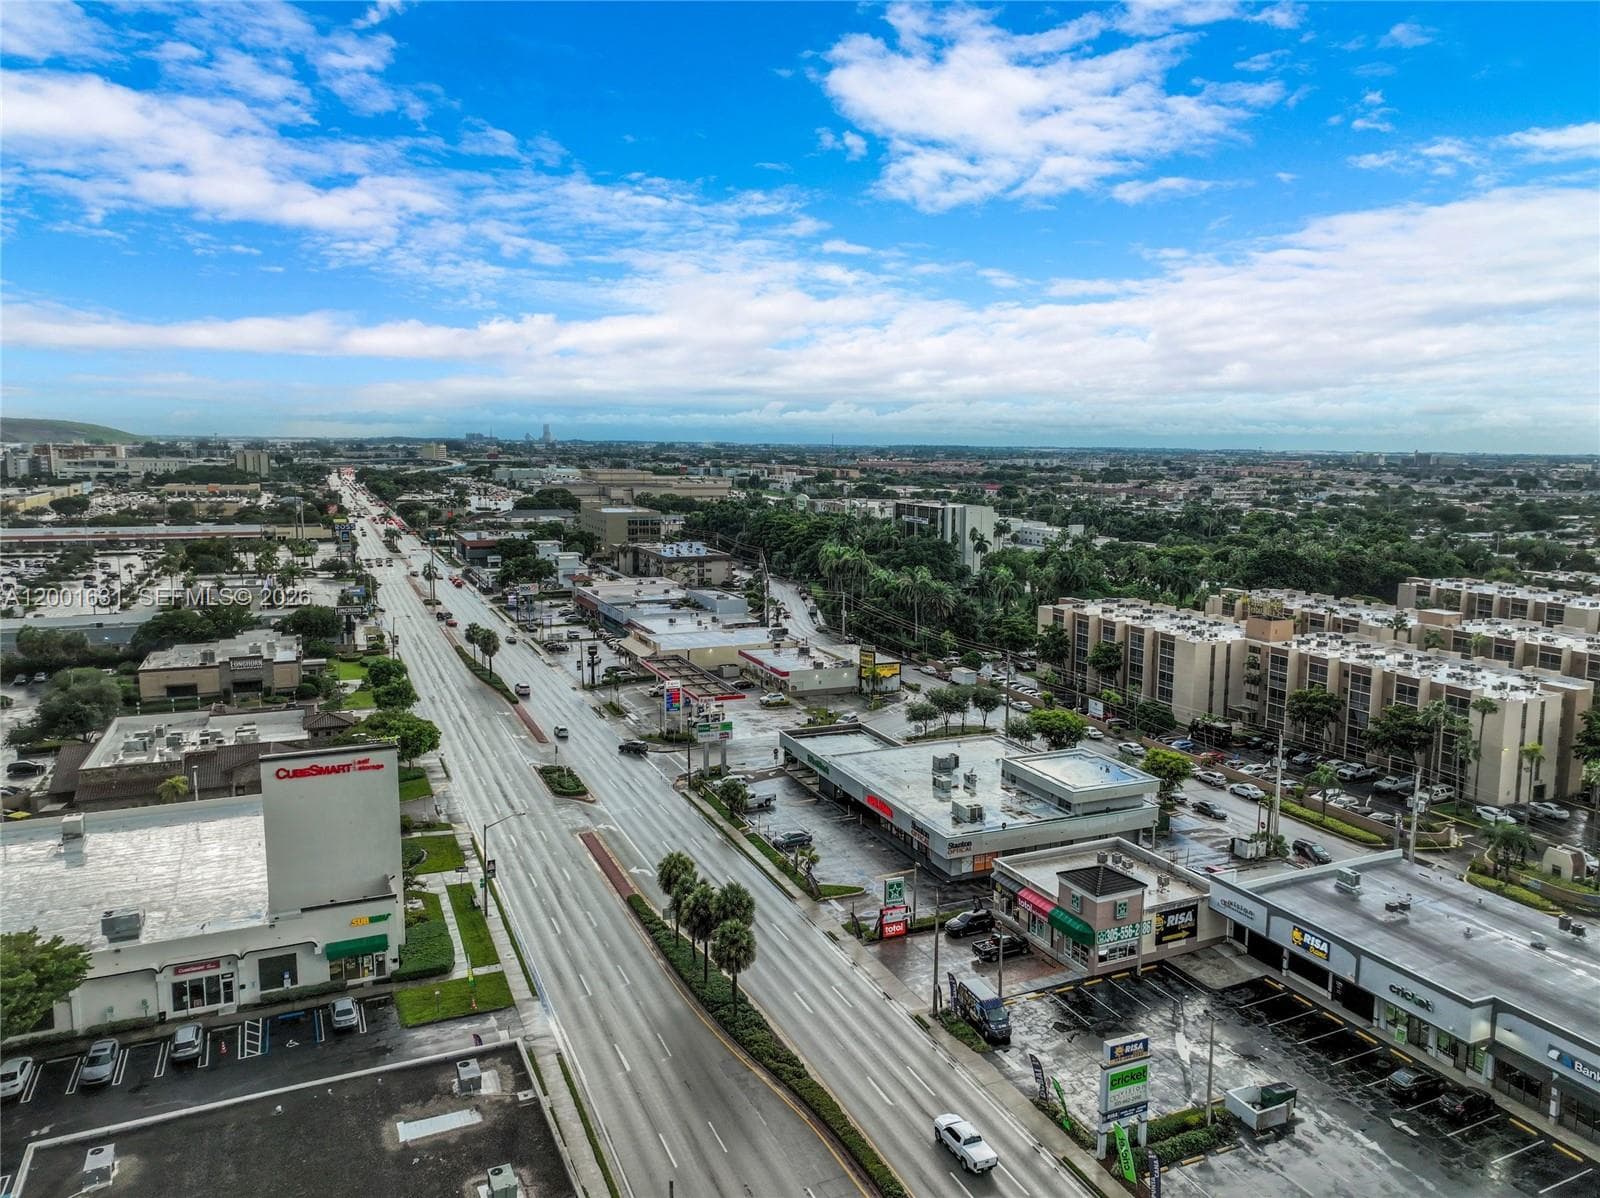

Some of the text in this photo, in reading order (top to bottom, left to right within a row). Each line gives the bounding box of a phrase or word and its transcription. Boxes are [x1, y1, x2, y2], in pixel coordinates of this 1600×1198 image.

[948, 840, 972, 850] Stanton
[885, 921, 903, 935] total
[1166, 910, 1194, 928] RISA
[1105, 920, 1151, 941] 305-556-286
[1302, 933, 1330, 953] RISA
[1389, 983, 1434, 1013] cricket
[1124, 1041, 1144, 1054] RISA
[1110, 1068, 1147, 1088] cricket
